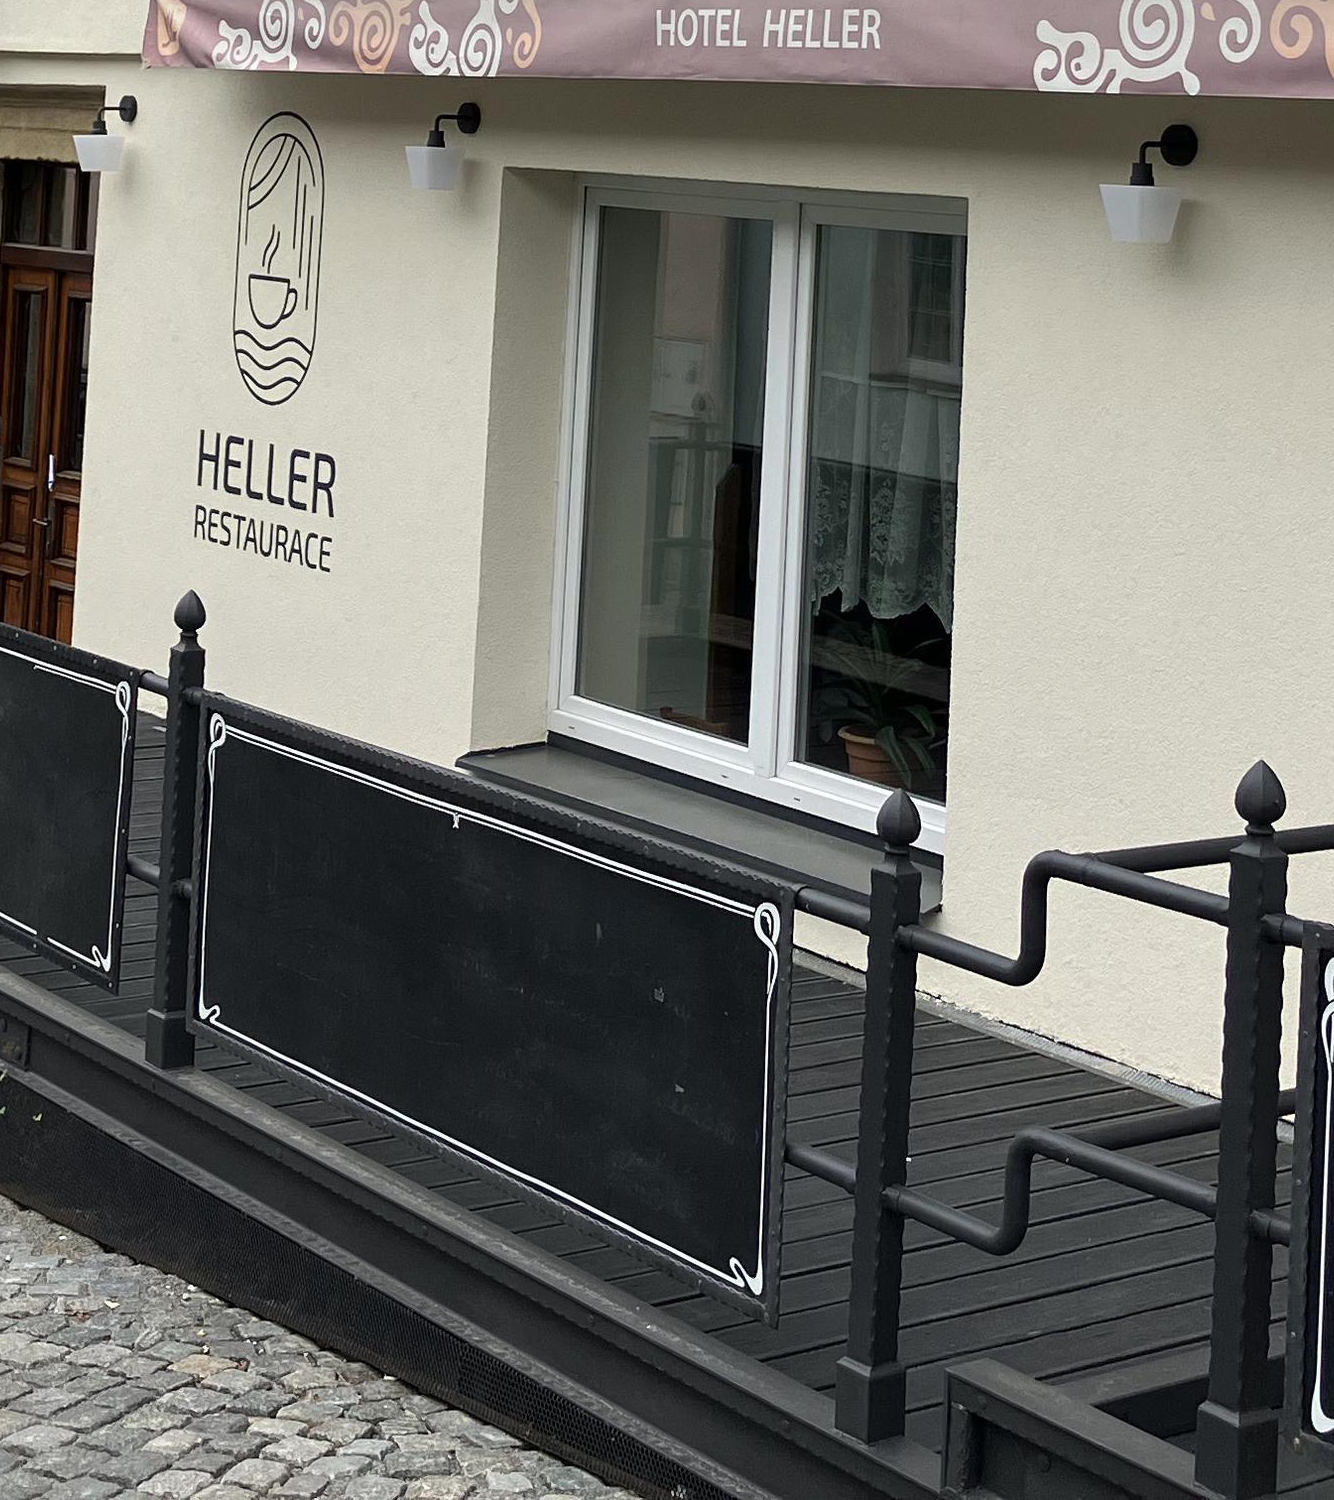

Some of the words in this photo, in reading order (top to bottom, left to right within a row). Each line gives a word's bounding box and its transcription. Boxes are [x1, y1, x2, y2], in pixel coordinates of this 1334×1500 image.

[655, 8, 747, 48] HOTEL
[762, 8, 881, 49] HELLER
[197, 429, 336, 518] HELLER
[194, 504, 333, 573] RESTAURACE
